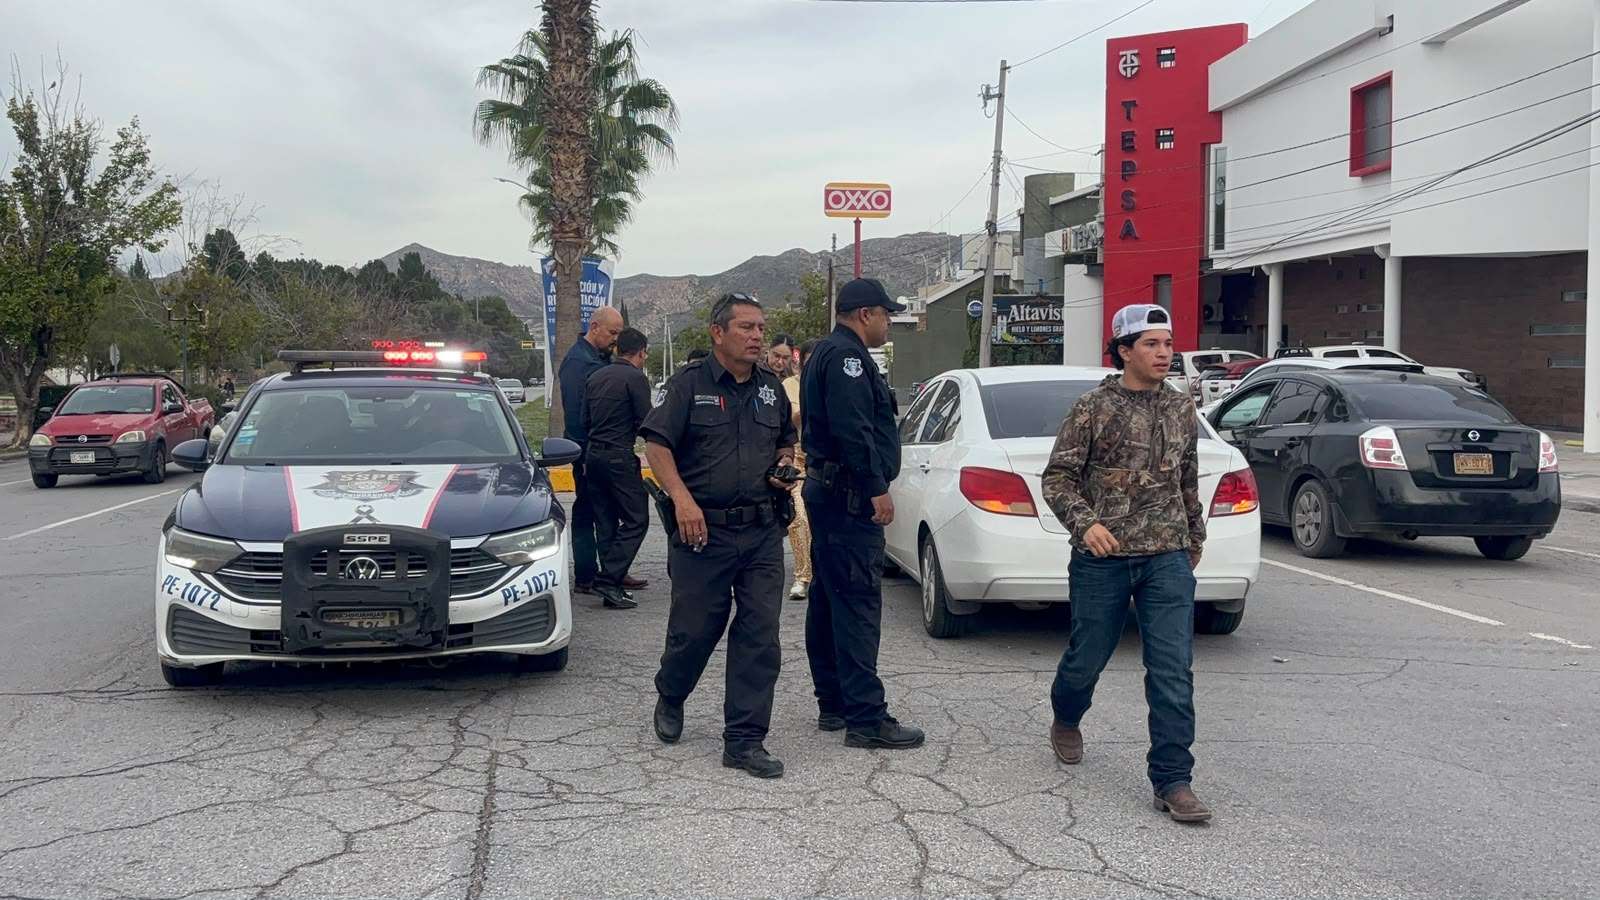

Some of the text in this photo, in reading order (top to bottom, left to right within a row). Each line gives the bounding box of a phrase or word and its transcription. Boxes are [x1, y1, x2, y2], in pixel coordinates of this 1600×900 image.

[1119, 100, 1138, 240] TEPSA
[828, 190, 889, 210] OXXO
[1008, 304, 1065, 322] Altavist
[339, 472, 401, 481] SSPE
[346, 535, 388, 543] SSPE
[161, 574, 221, 611] PE-1072
[501, 569, 558, 607] PE-1072
